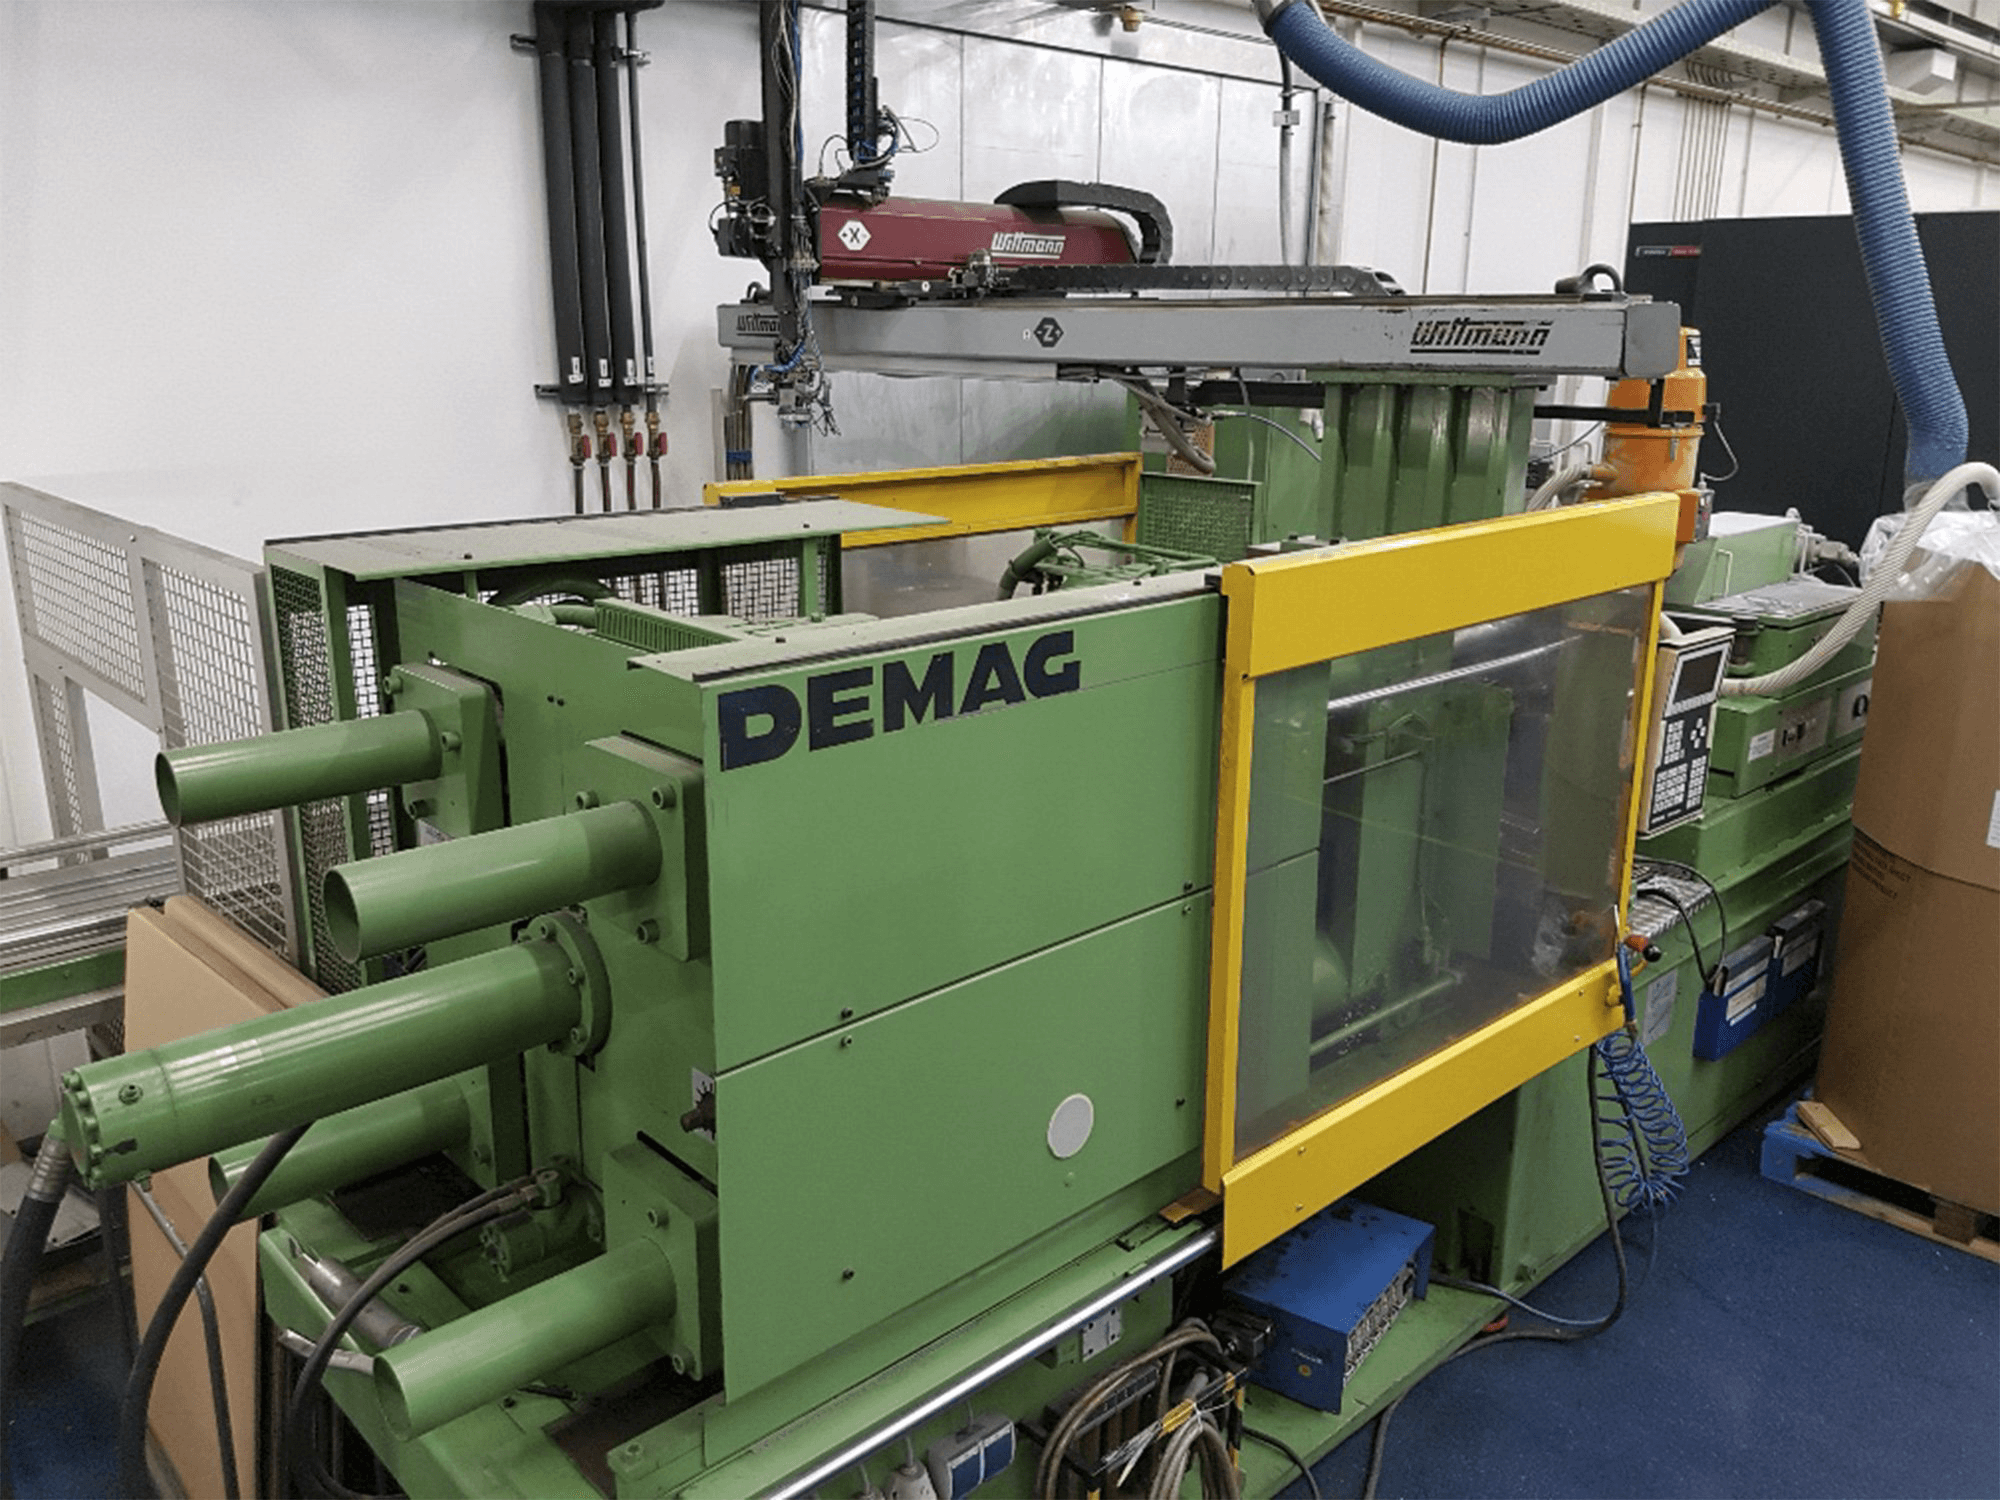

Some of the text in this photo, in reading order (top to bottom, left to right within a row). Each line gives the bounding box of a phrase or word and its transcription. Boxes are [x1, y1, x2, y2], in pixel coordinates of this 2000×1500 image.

[848, 227, 860, 243] X
[991, 231, 1065, 257] Wittmann
[736, 313, 780, 336] Wittma
[1410, 317, 1552, 351] Wittmann
[717, 630, 1081, 773] DEMAG
